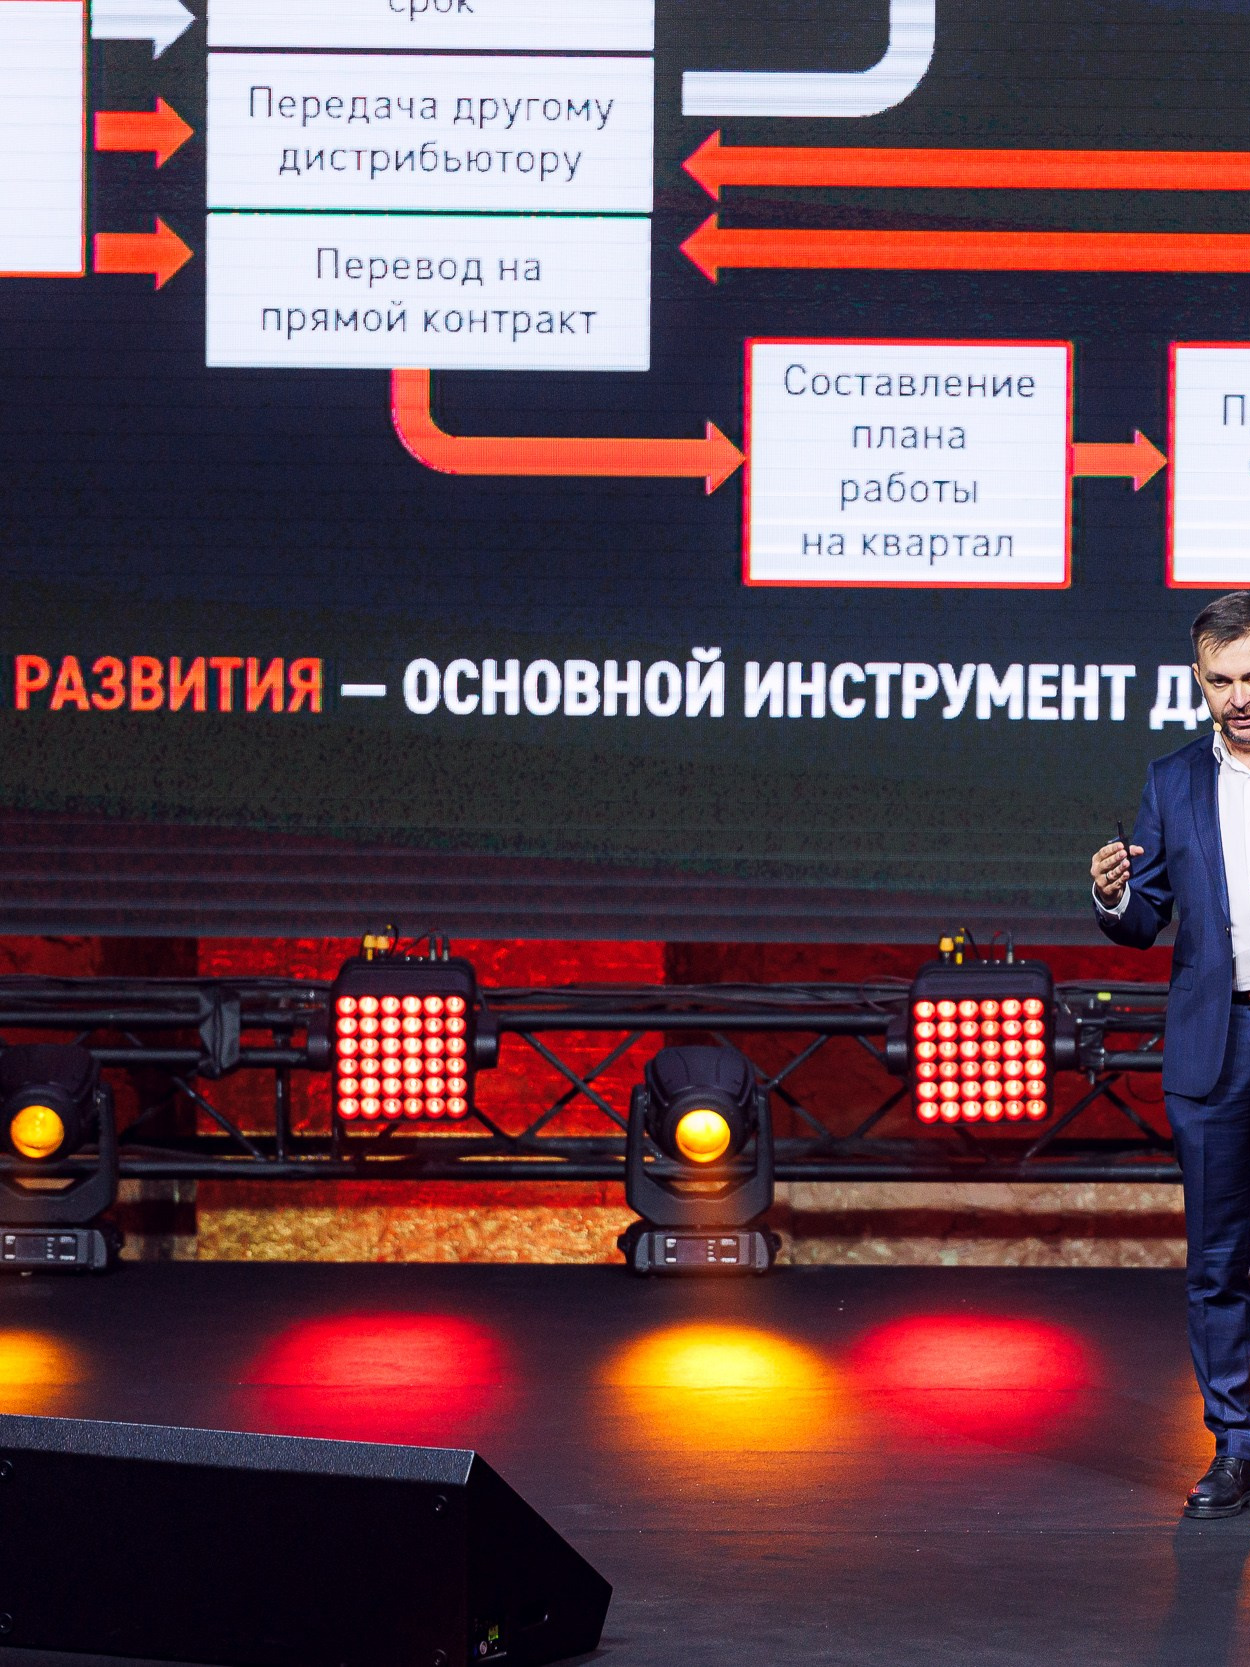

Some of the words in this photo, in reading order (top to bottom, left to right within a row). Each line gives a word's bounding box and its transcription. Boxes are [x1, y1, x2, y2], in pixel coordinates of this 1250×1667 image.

[249, 85, 437, 128] Передача
[453, 97, 614, 131] другому
[279, 141, 582, 182] дистрибьютору
[317, 247, 483, 289] Перевод
[499, 259, 541, 281] на
[262, 300, 406, 341] прямой
[423, 309, 597, 343] контракт
[783, 363, 1035, 398] Составление
[853, 425, 966, 450] плана
[840, 471, 977, 511] работы
[803, 533, 845, 556] на
[862, 533, 1013, 566] квартал
[15, 654, 323, 713] РАЗВИТИЯ
[403, 646, 725, 718] ОСНОВНОЙ
[744, 661, 1137, 721] ИНСТРУМЕНТ
